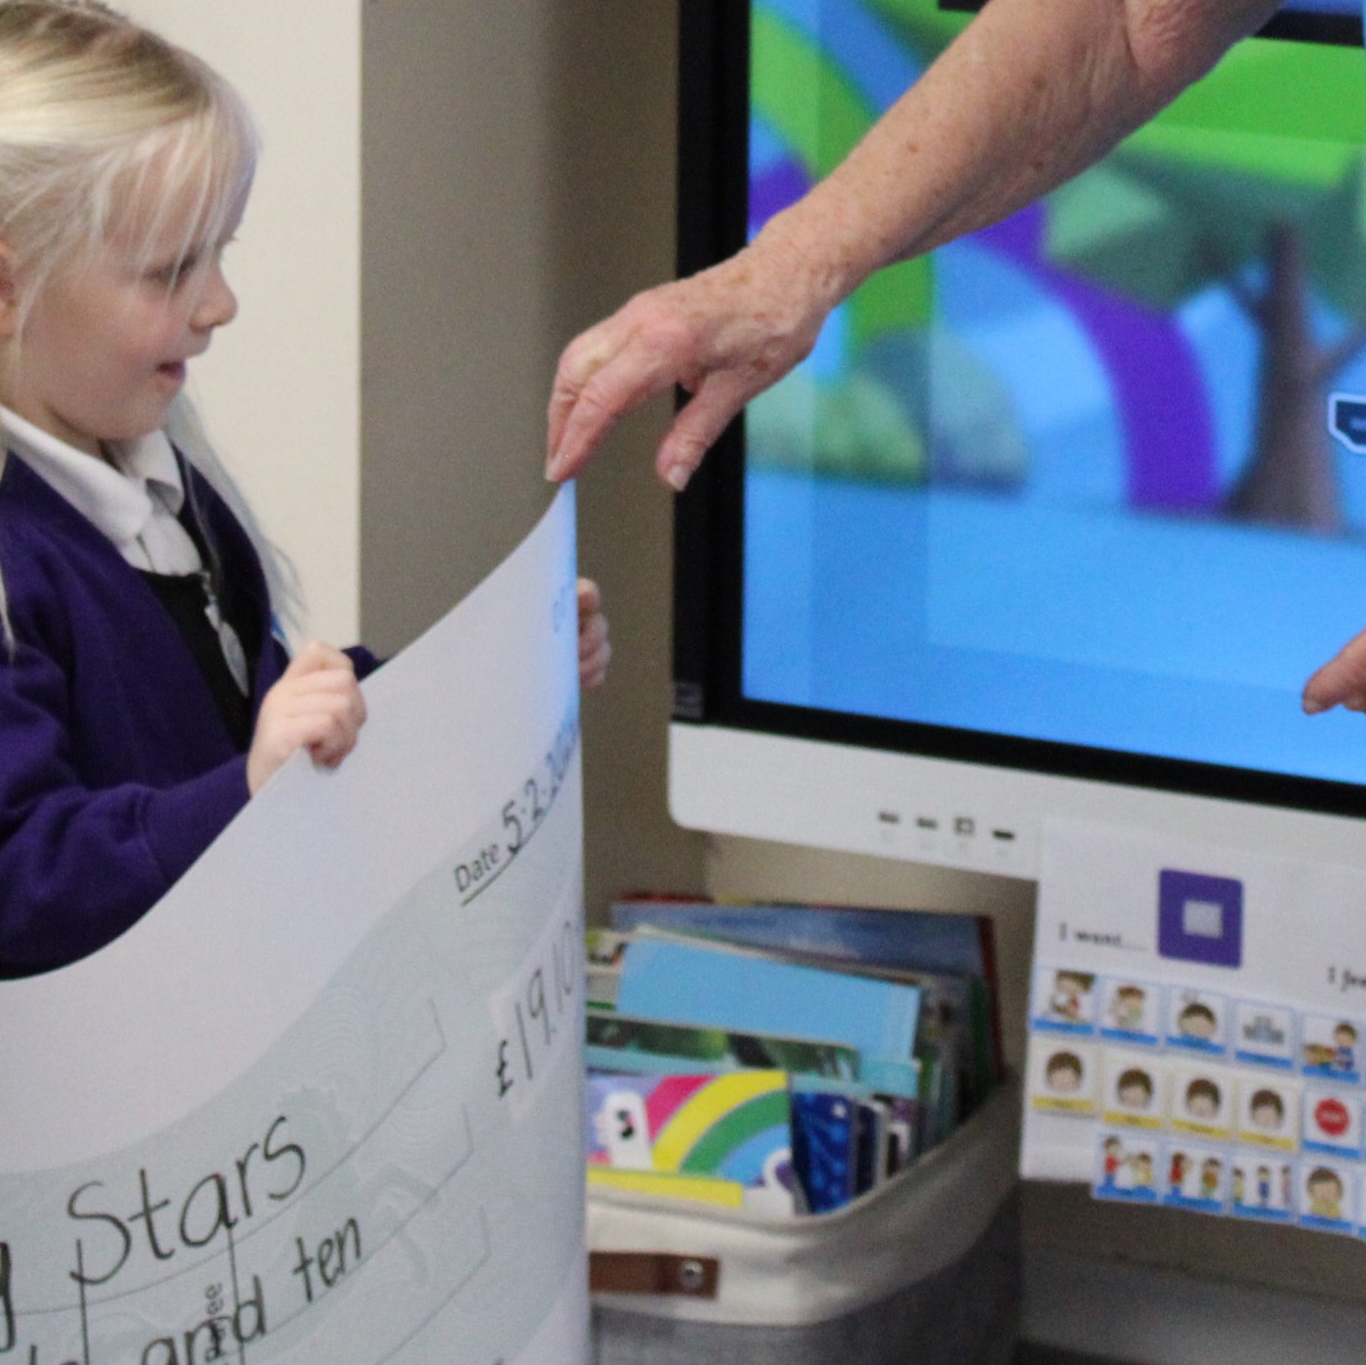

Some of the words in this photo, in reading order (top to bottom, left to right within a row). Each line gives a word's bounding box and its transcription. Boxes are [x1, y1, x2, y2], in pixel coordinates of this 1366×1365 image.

[453, 842, 501, 893] Date
[68, 1115, 307, 1289] Stars
[293, 1216, 363, 1302] ten
